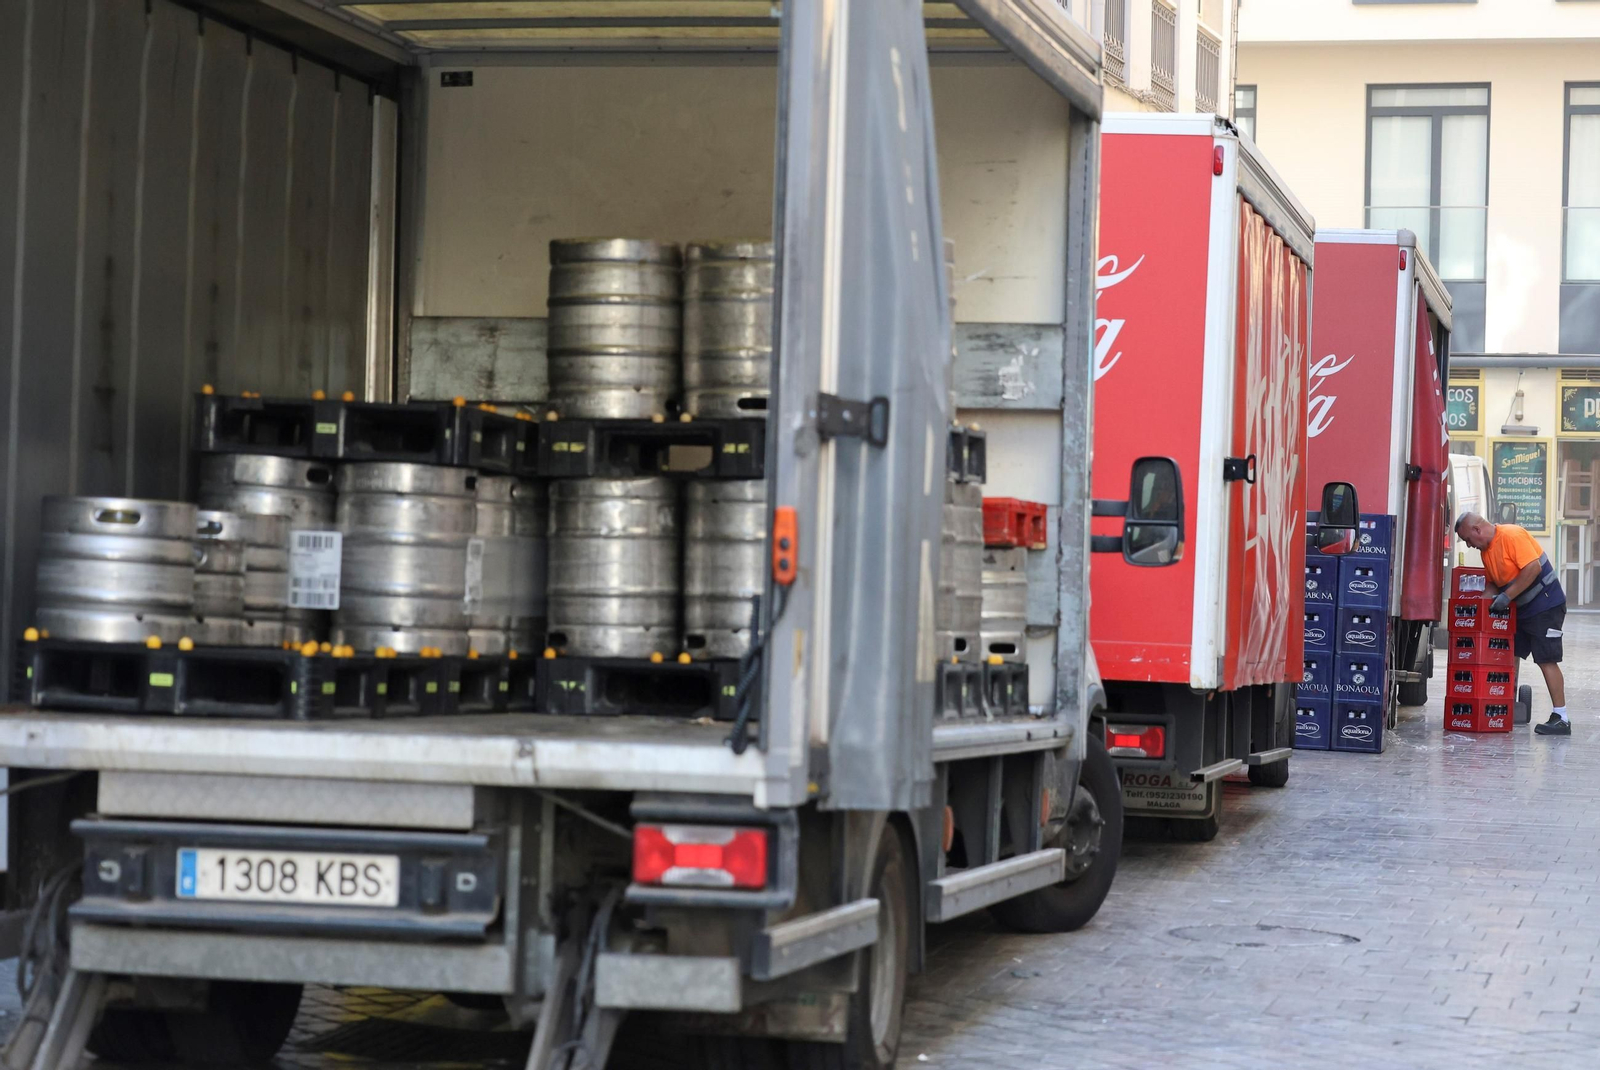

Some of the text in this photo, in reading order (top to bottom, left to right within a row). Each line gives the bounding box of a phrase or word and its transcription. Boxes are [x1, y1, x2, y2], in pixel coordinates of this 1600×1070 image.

[1508, 476, 1543, 485] RACIONES
[1454, 619, 1475, 628] Coca-Cola
[1492, 620, 1508, 631] Coca-Cola
[1336, 684, 1380, 695] BONAQUA
[1454, 684, 1472, 693] Coca-Cola
[1489, 686, 1505, 695] Coca-Cola
[1451, 718, 1472, 728] Coca-Cola
[1488, 718, 1504, 728] Coca-Cola
[217, 856, 382, 897] 1308 KBS
